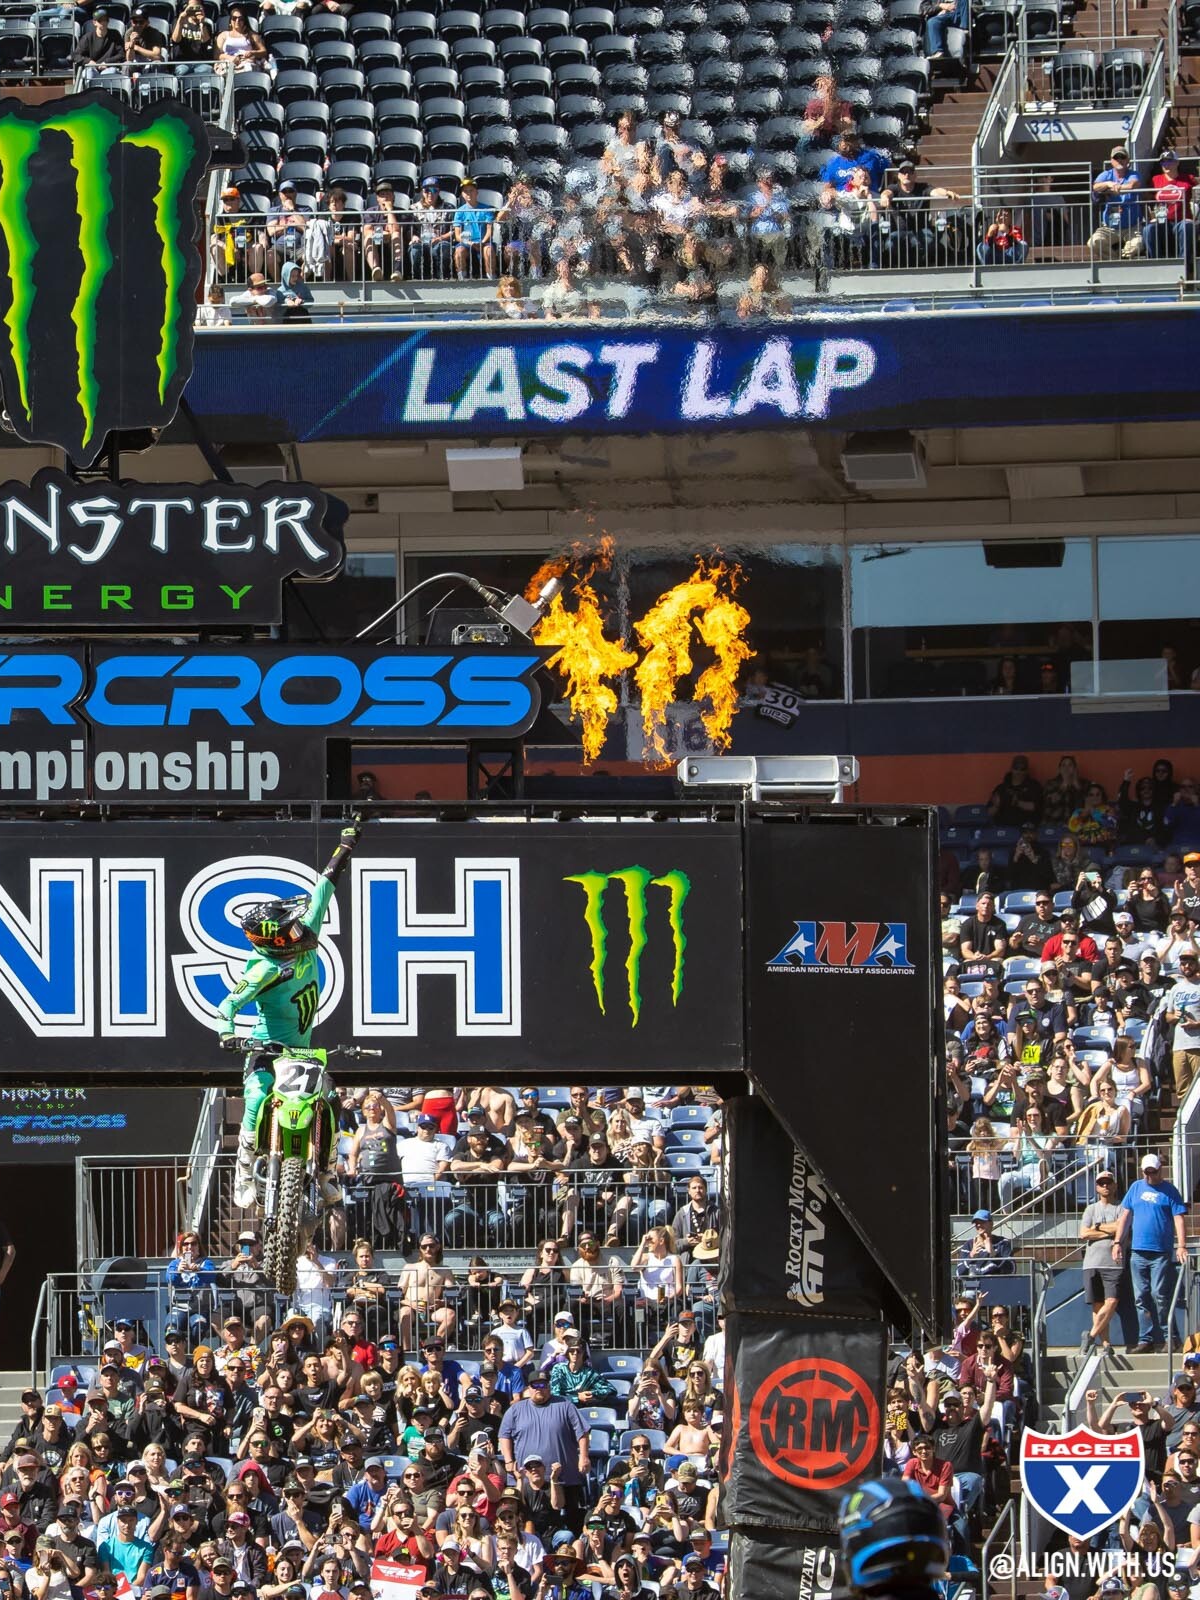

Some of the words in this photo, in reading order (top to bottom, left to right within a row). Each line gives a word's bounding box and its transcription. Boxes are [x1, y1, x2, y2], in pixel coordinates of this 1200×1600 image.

[1030, 119, 1061, 134] 325
[403, 343, 661, 422] LAST
[680, 335, 878, 420] LAP
[765, 690, 798, 709] 30
[765, 921, 916, 967] AMA
[278, 1065, 321, 1094] 21
[12, 1133, 82, 1145] Championship
[789, 1146, 806, 1213] MOUN
[785, 1214, 803, 1280] ROCKY
[776, 1397, 856, 1453] RM
[799, 1547, 816, 1600] NTAIN
